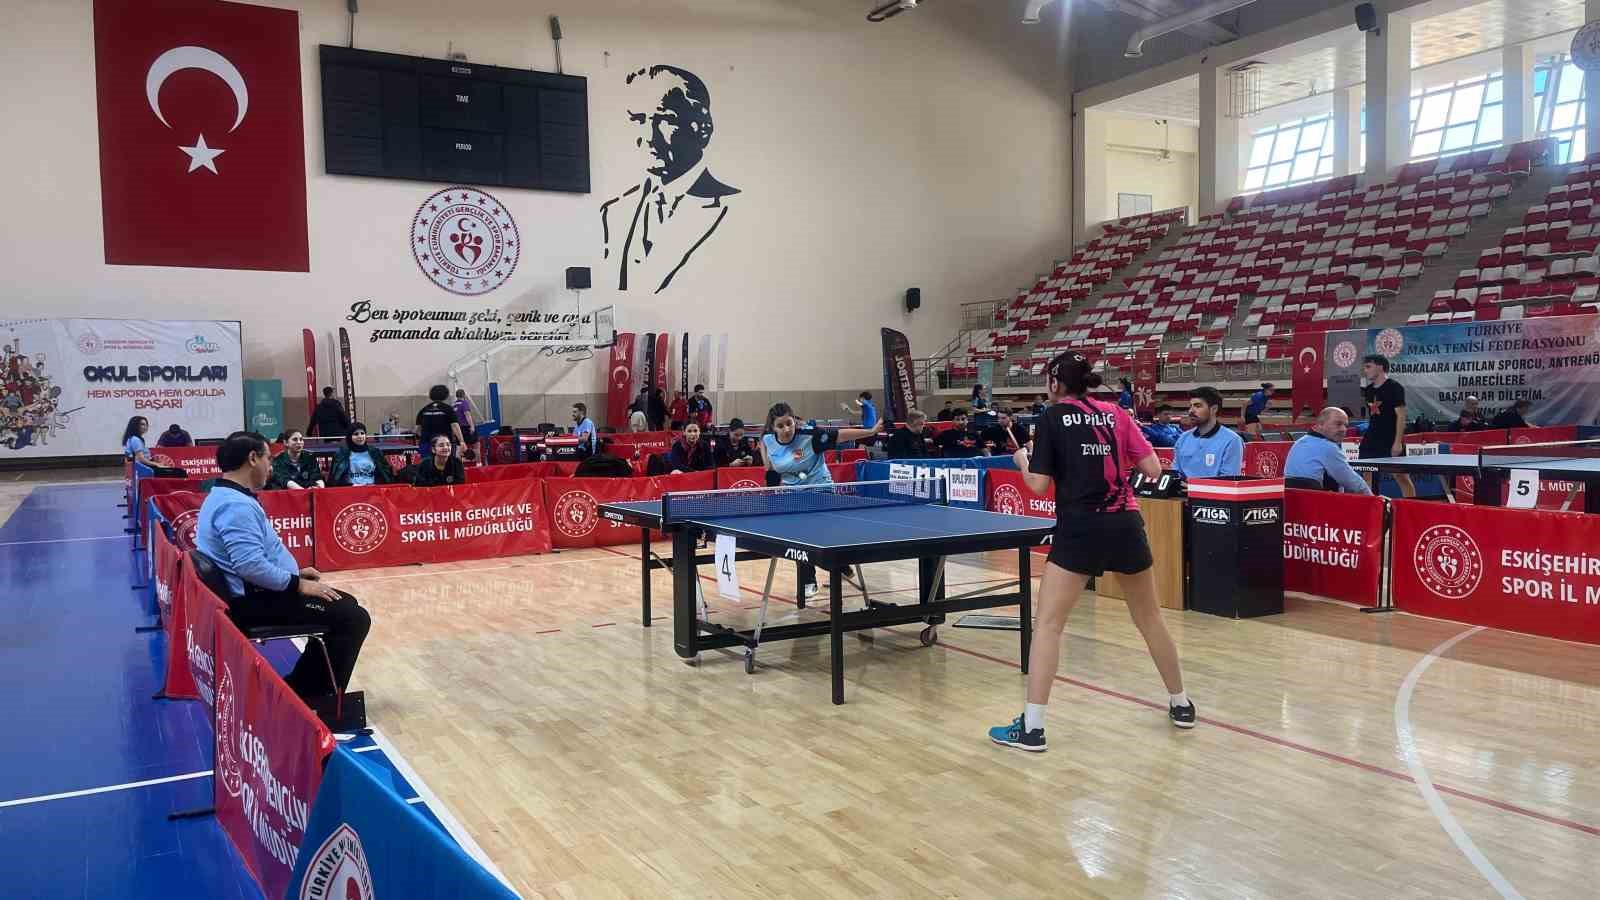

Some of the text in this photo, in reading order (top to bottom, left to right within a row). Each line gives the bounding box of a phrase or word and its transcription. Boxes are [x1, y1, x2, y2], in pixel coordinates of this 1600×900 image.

[346, 300, 389, 324] Ben
[544, 313, 559, 323] ve
[370, 329, 439, 343] zamanda
[1466, 322, 1522, 337] TÜRKİYE
[1407, 335, 1586, 356] MASA TENİSİ FEDERASYONU
[83, 365, 228, 382] OKUL SPORLARI
[1390, 361, 1450, 374] SABAKALARA
[1453, 360, 1496, 372] KATILAN
[1498, 358, 1545, 371] SPORCU,
[1458, 374, 1525, 387] İDARECİLERE
[88, 387, 225, 398] HEM SPORDA HEM OKULDA
[135, 400, 183, 411] BAŞARI
[1062, 413, 1116, 428] BU PİLİÇ
[184, 466, 200, 474] POR
[1517, 480, 1530, 496] 5
[400, 503, 532, 527] ESKİŞEHİR GENÇLİK VE
[1193, 507, 1228, 520] STIGA
[1243, 508, 1278, 520] STIGA
[402, 519, 533, 543] SPOR İL MÜDÜRLÜĞÜ
[1283, 521, 1362, 546] GENÇLİK VE
[288, 533, 301, 548] İL
[785, 548, 809, 562] STIGA
[1283, 541, 1359, 569] ÜDÜRLÜĞÜ
[1501, 548, 1600, 576] ESKİŞEHİR
[721, 553, 731, 582] 4
[1502, 576, 1553, 600] SPOR
[1560, 579, 1577, 603] İL
